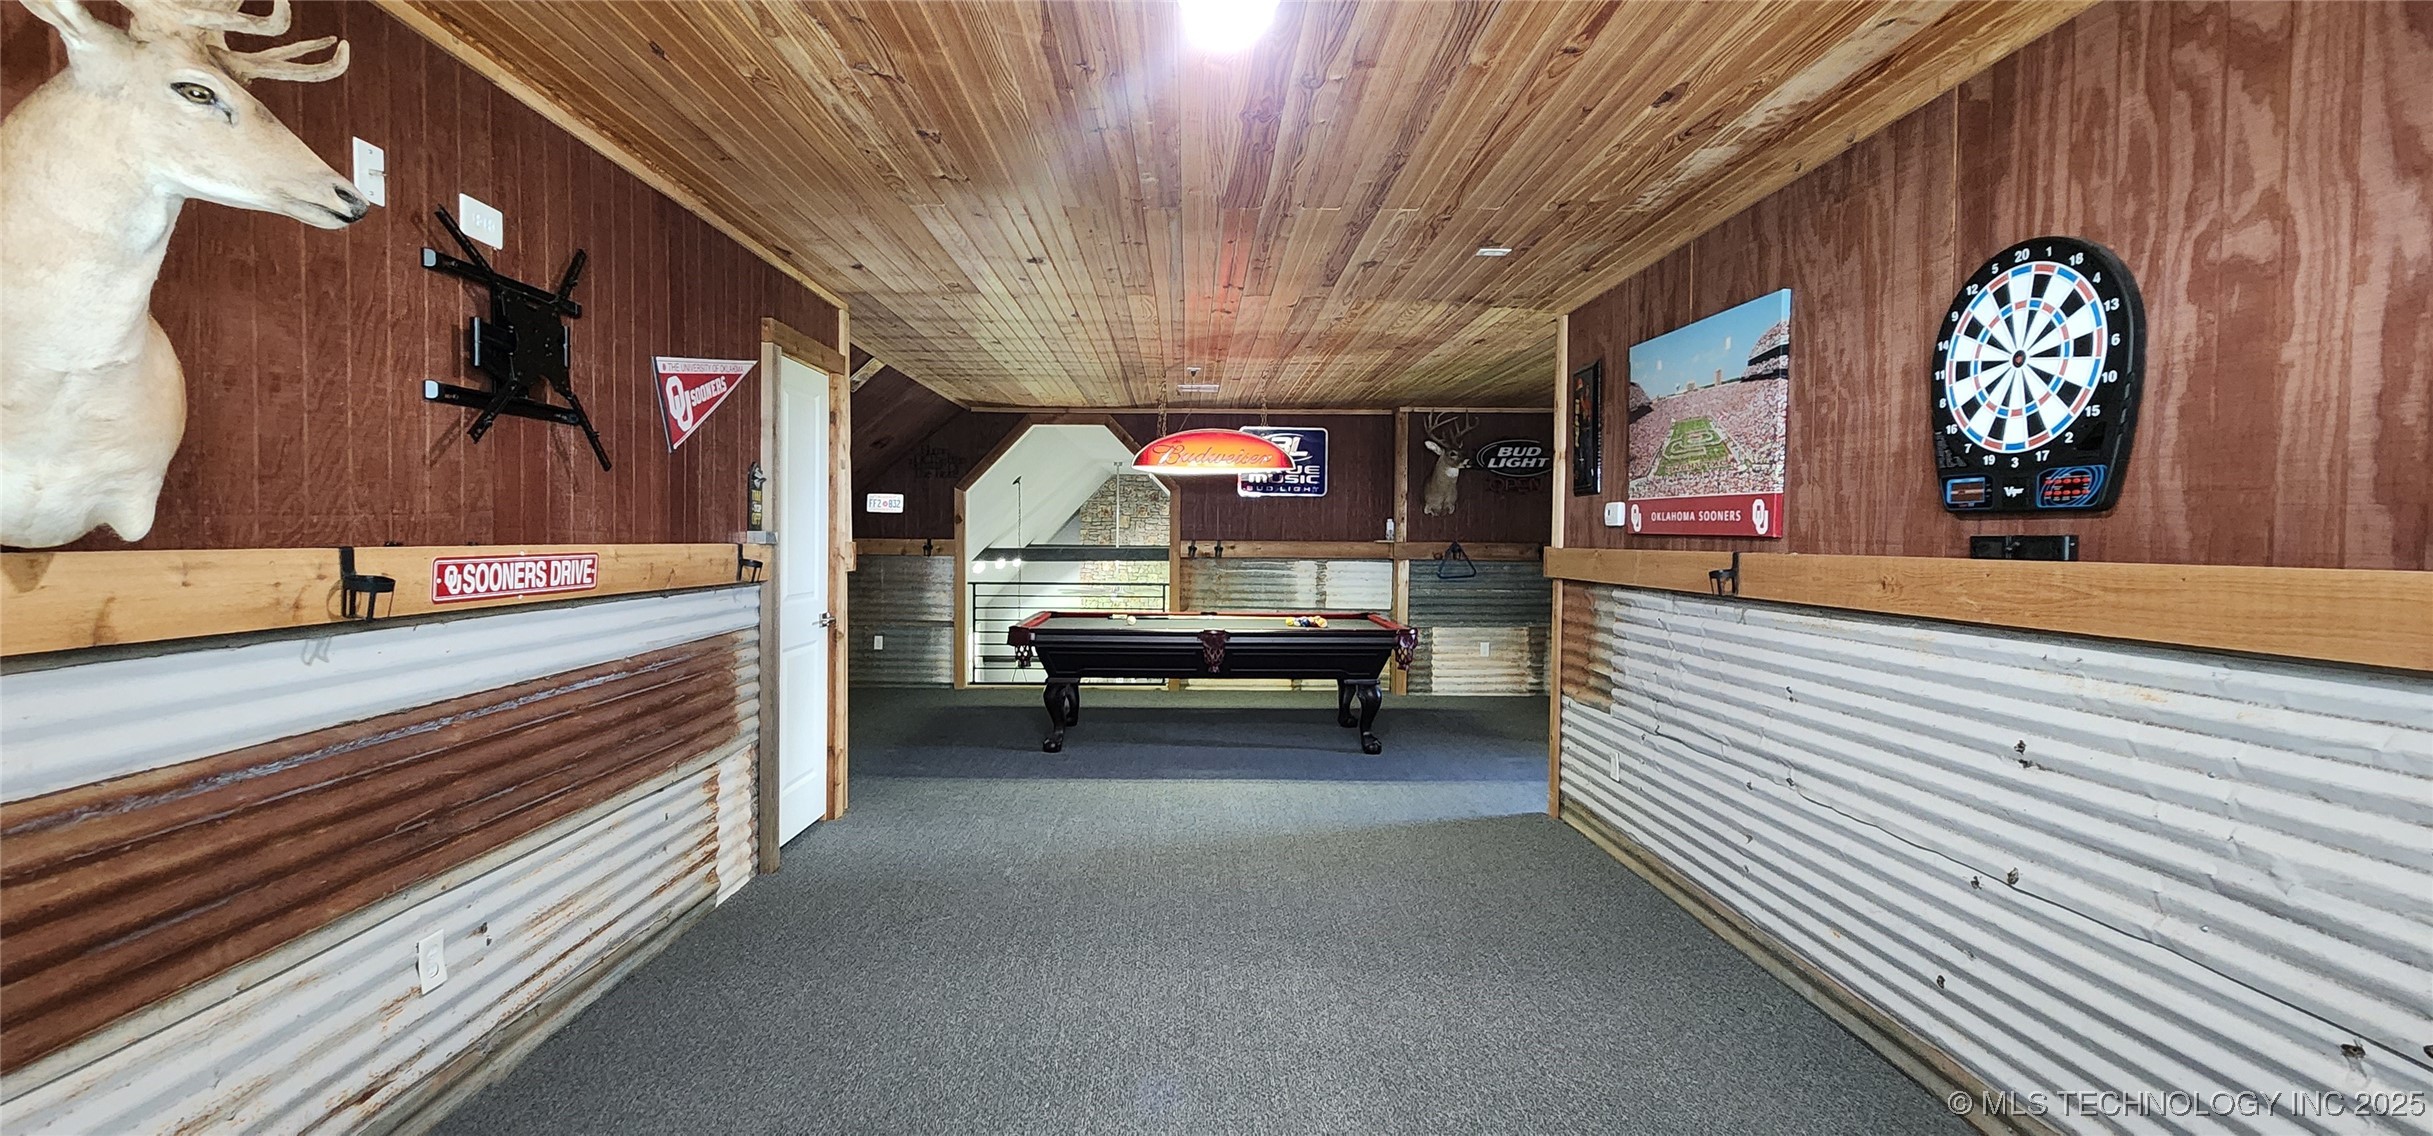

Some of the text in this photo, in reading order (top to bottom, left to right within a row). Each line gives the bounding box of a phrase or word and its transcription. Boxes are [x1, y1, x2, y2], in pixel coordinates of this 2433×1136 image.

[2014, 247, 2031, 262] 20
[2045, 246, 2052, 257] 1
[2069, 252, 2084, 266] 18
[1991, 263, 1999, 275] 5
[2092, 271, 2101, 283] 4
[1965, 284, 1979, 296] 12
[2104, 298, 2120, 312] 13
[1951, 311, 1959, 322] 9
[2111, 333, 2121, 345] 6
[1937, 340, 1949, 351] 14
[667, 362, 744, 373] THE UNIVERSITY OF OKLAHOMA
[1934, 370, 1946, 381] 11
[2102, 371, 2118, 383] 10
[665, 375, 728, 432] OU SOONERS
[1939, 398, 1947, 408] 8
[2085, 405, 2101, 417] 15
[1945, 423, 1958, 435] 16
[2064, 432, 2073, 444] 2
[1497, 446, 1542, 457] BUD
[1964, 443, 1972, 454] 7
[1152, 444, 1273, 466] Budweiser
[1982, 454, 1996, 466] 19
[2035, 450, 2050, 462] 17
[1487, 457, 1551, 468] LIGHT
[2010, 457, 2019, 468] 3
[1248, 473, 1320, 484] MUSIC
[1651, 510, 1742, 522] OKLAHOMA SOONERS
[444, 558, 593, 595] OU SOONERS DRIVE
